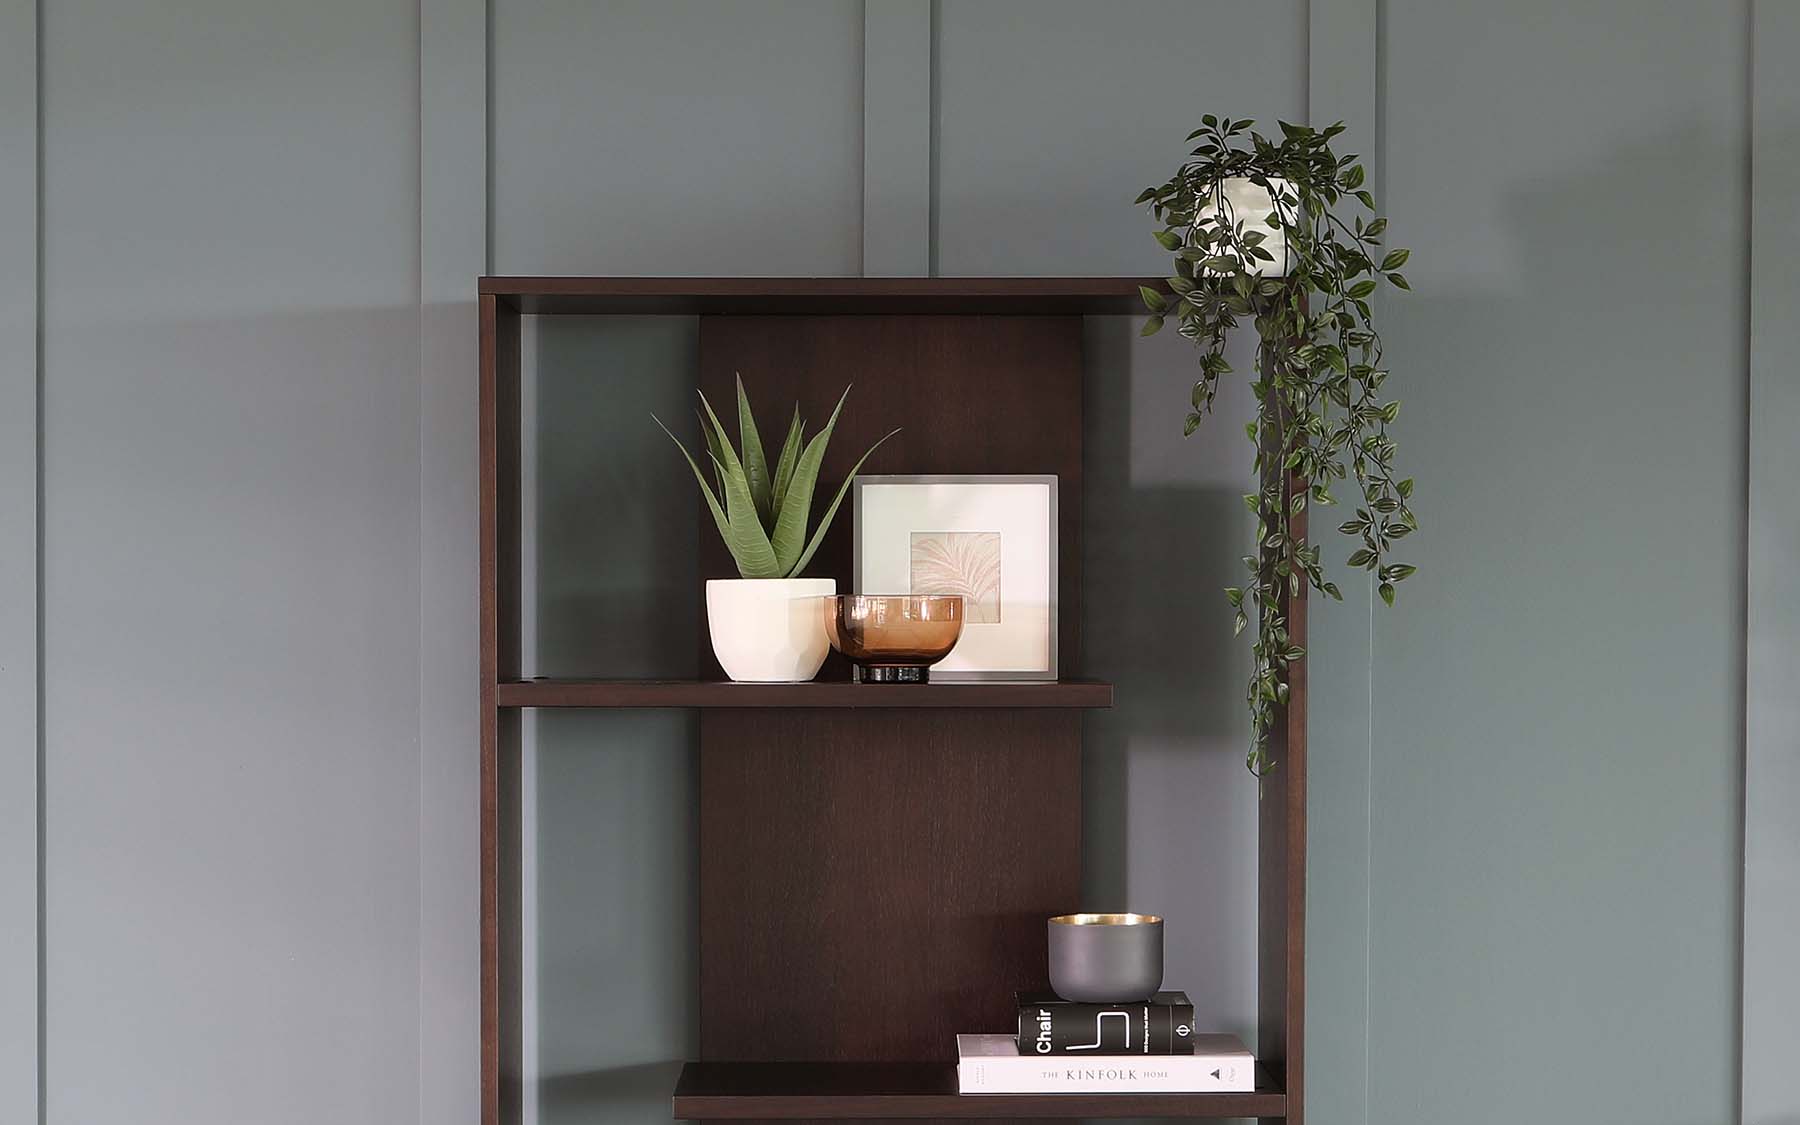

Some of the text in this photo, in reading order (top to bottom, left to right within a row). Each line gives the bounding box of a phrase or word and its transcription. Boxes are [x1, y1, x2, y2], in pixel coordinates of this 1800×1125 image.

[1036, 1009, 1052, 1054] Chair
[1042, 1069, 1169, 1081] THE KINFOLK HOME
